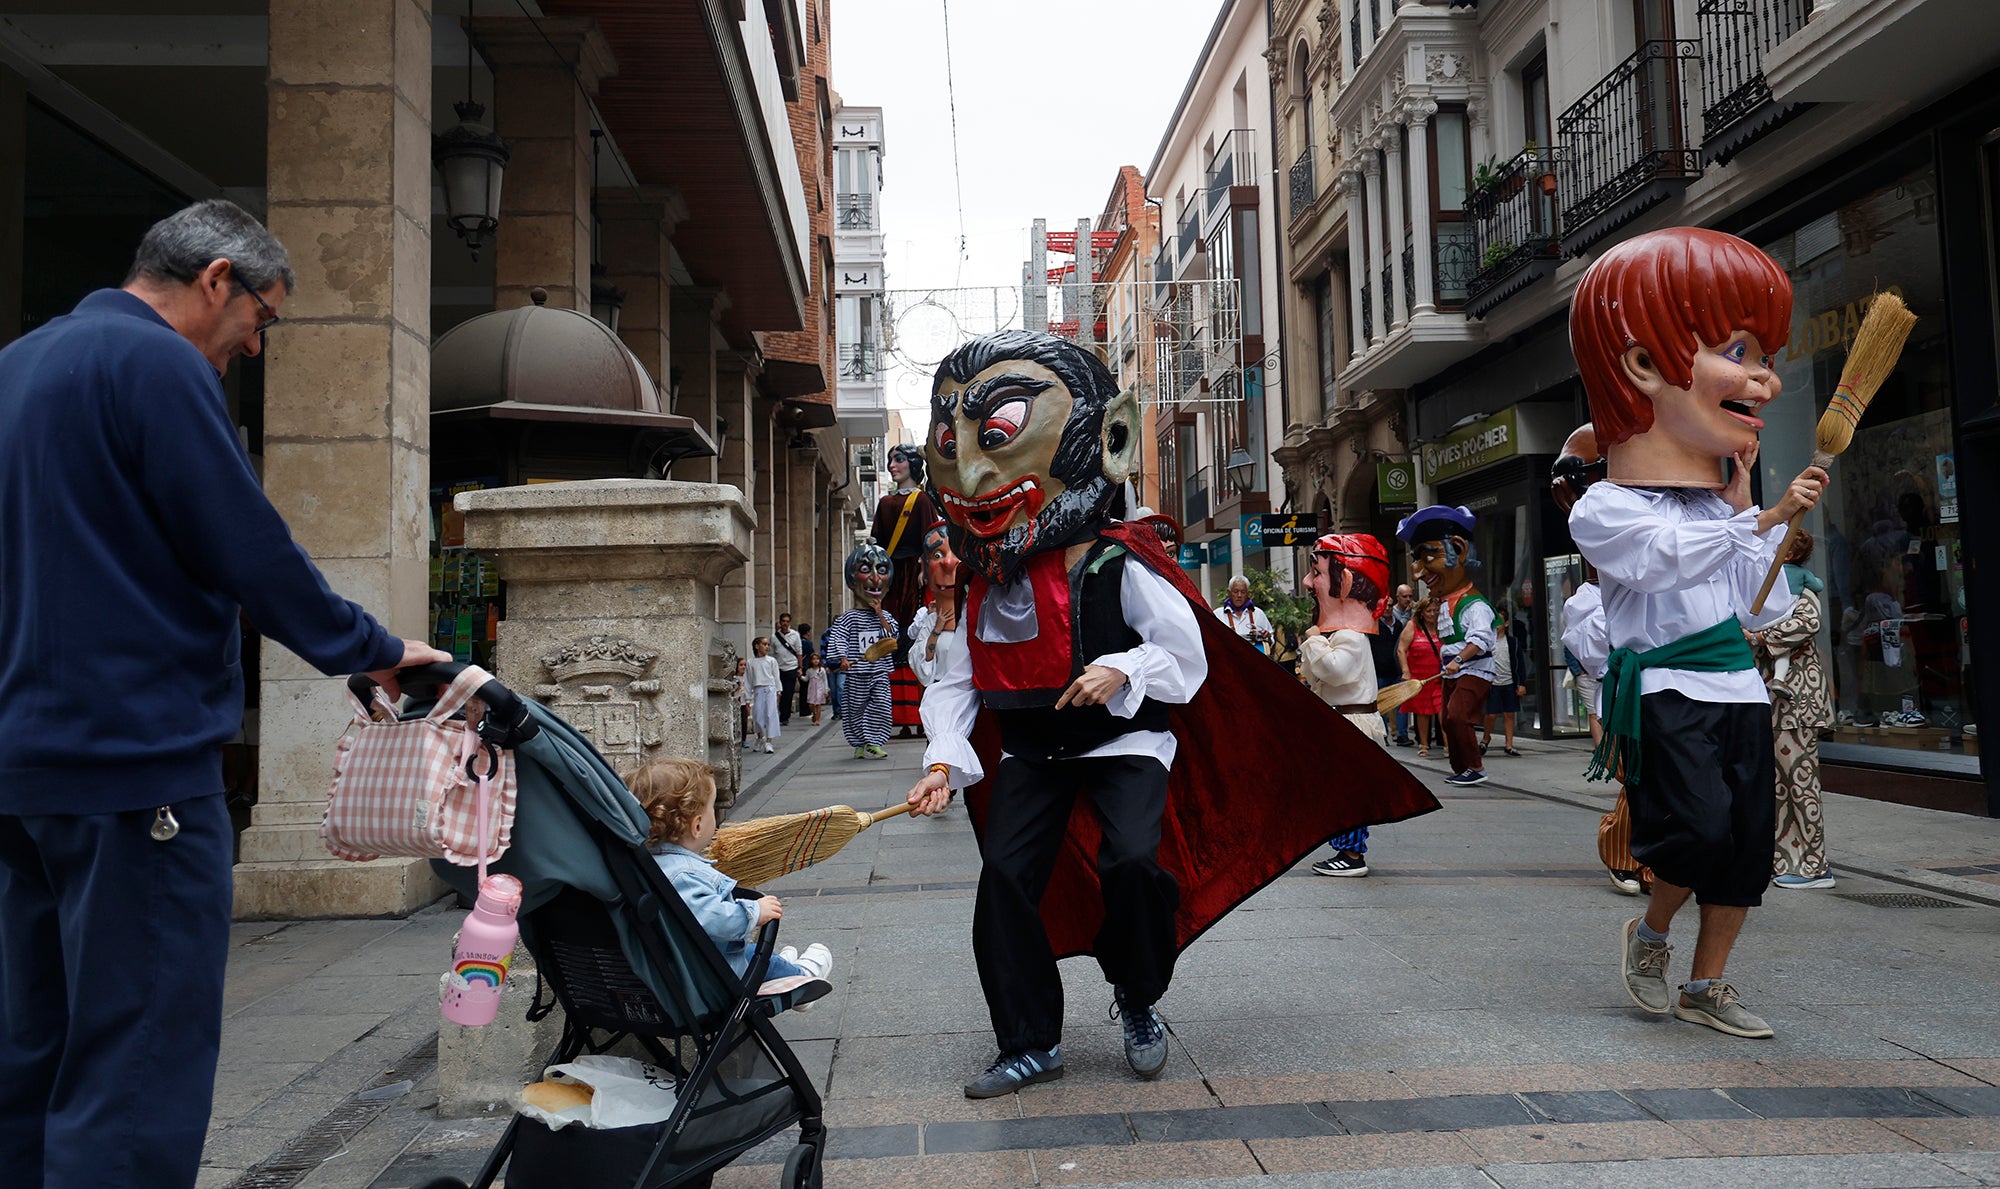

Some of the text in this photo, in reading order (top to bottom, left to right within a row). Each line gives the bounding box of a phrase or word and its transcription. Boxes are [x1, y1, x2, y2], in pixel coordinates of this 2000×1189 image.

[1786, 284, 1904, 362] LOBA
[1437, 424, 1508, 466] YVES ROCHER
[1457, 453, 1486, 470] FRANCE
[861, 636, 880, 648] 14
[466, 952, 499, 961] RAINBOW
